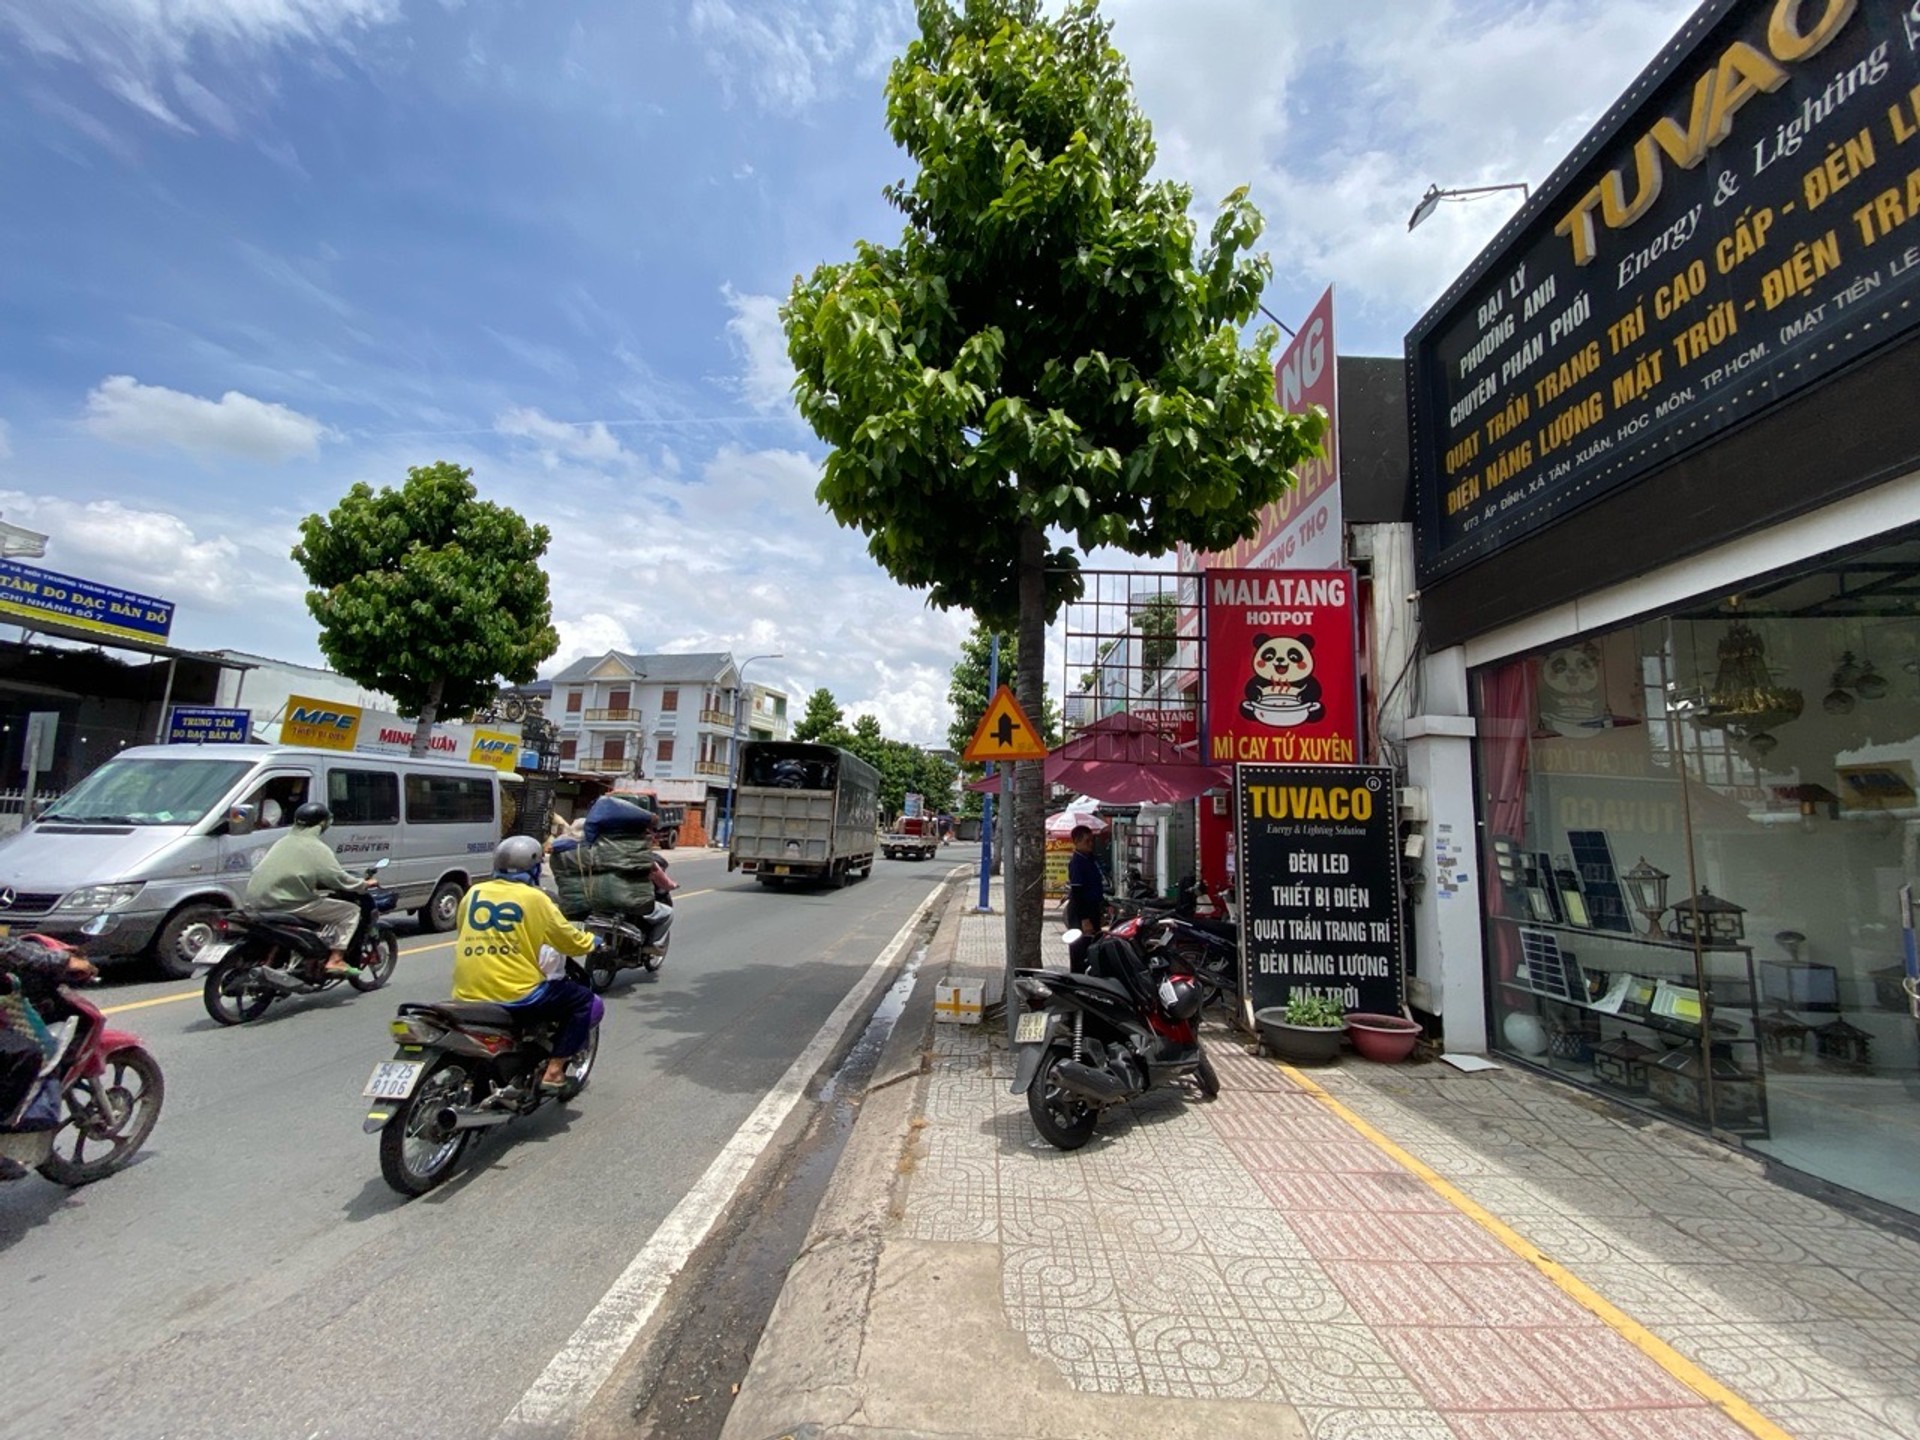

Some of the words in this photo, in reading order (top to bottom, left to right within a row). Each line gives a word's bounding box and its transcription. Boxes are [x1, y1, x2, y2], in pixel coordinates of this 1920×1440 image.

[1617, 202, 1702, 290] Energy
[1713, 169, 1740, 208] &
[1753, 40, 1889, 178] Lighting
[1446, 430, 1480, 475] QUẠT
[1486, 391, 1530, 445] TRẦN
[1535, 340, 1600, 409] TRANG
[1607, 294, 1646, 355] TRÍ
[1654, 259, 1707, 321] CAO
[1716, 205, 1774, 275] CẤP
[1803, 127, 1876, 211] ĐÈN
[1477, 288, 1503, 331] ĐẠI
[1509, 261, 1527, 299] LÝ
[1460, 313, 1515, 380] PHƯƠNG
[1523, 274, 1556, 323] ANH
[1447, 475, 1481, 516] ĐIỆN
[1485, 439, 1533, 490] NĂNG
[1538, 391, 1604, 457] LƯỢNG
[1612, 348, 1663, 409] MẶT
[1673, 298, 1738, 368] TRỜI
[1761, 229, 1842, 312] ĐIỆN
[1450, 372, 1497, 428] CHUYÊN
[1502, 332, 1544, 385] PHÂN
[1550, 289, 1590, 347] PHỐI
[1548, 460, 1571, 481] TÂN
[43, 586, 67, 600] ĐO
[71, 592, 106, 611] ĐẠC
[110, 602, 143, 619] BẢN
[1214, 579, 1345, 607] MALATANG
[26, 598, 73, 614] NHÁNH
[96, 613, 104, 621] 7
[1246, 611, 1313, 625] HOTPOT
[290, 706, 357, 729] MPE
[429, 735, 457, 752] UÂN
[474, 737, 517, 754] MPE
[1213, 730, 1233, 760] MÌ
[1239, 737, 1268, 761] CAY
[1272, 731, 1295, 761] TỨ
[1299, 732, 1353, 762] XUYÊN
[1248, 786, 1372, 821] TUVACO
[1267, 823, 1292, 837] Energy
[1302, 824, 1333, 837] Lighting
[1334, 824, 1366, 836] Solution
[1288, 850, 1318, 873] ĐÈN
[1322, 853, 1349, 874] LED
[469, 890, 523, 932] be
[1272, 879, 1311, 907] THIẾT
[1315, 886, 1330, 912] BỊ
[1334, 884, 1370, 912] ĐIỆN
[1254, 919, 1286, 944] QUẠT
[1288, 913, 1321, 941] TRẦN
[1325, 920, 1367, 942] TRANG
[1370, 917, 1391, 943] TRÍ
[1259, 949, 1289, 974] ĐÈN
[1293, 950, 1335, 975] NĂNG
[1339, 954, 1389, 981] LƯỢNG
